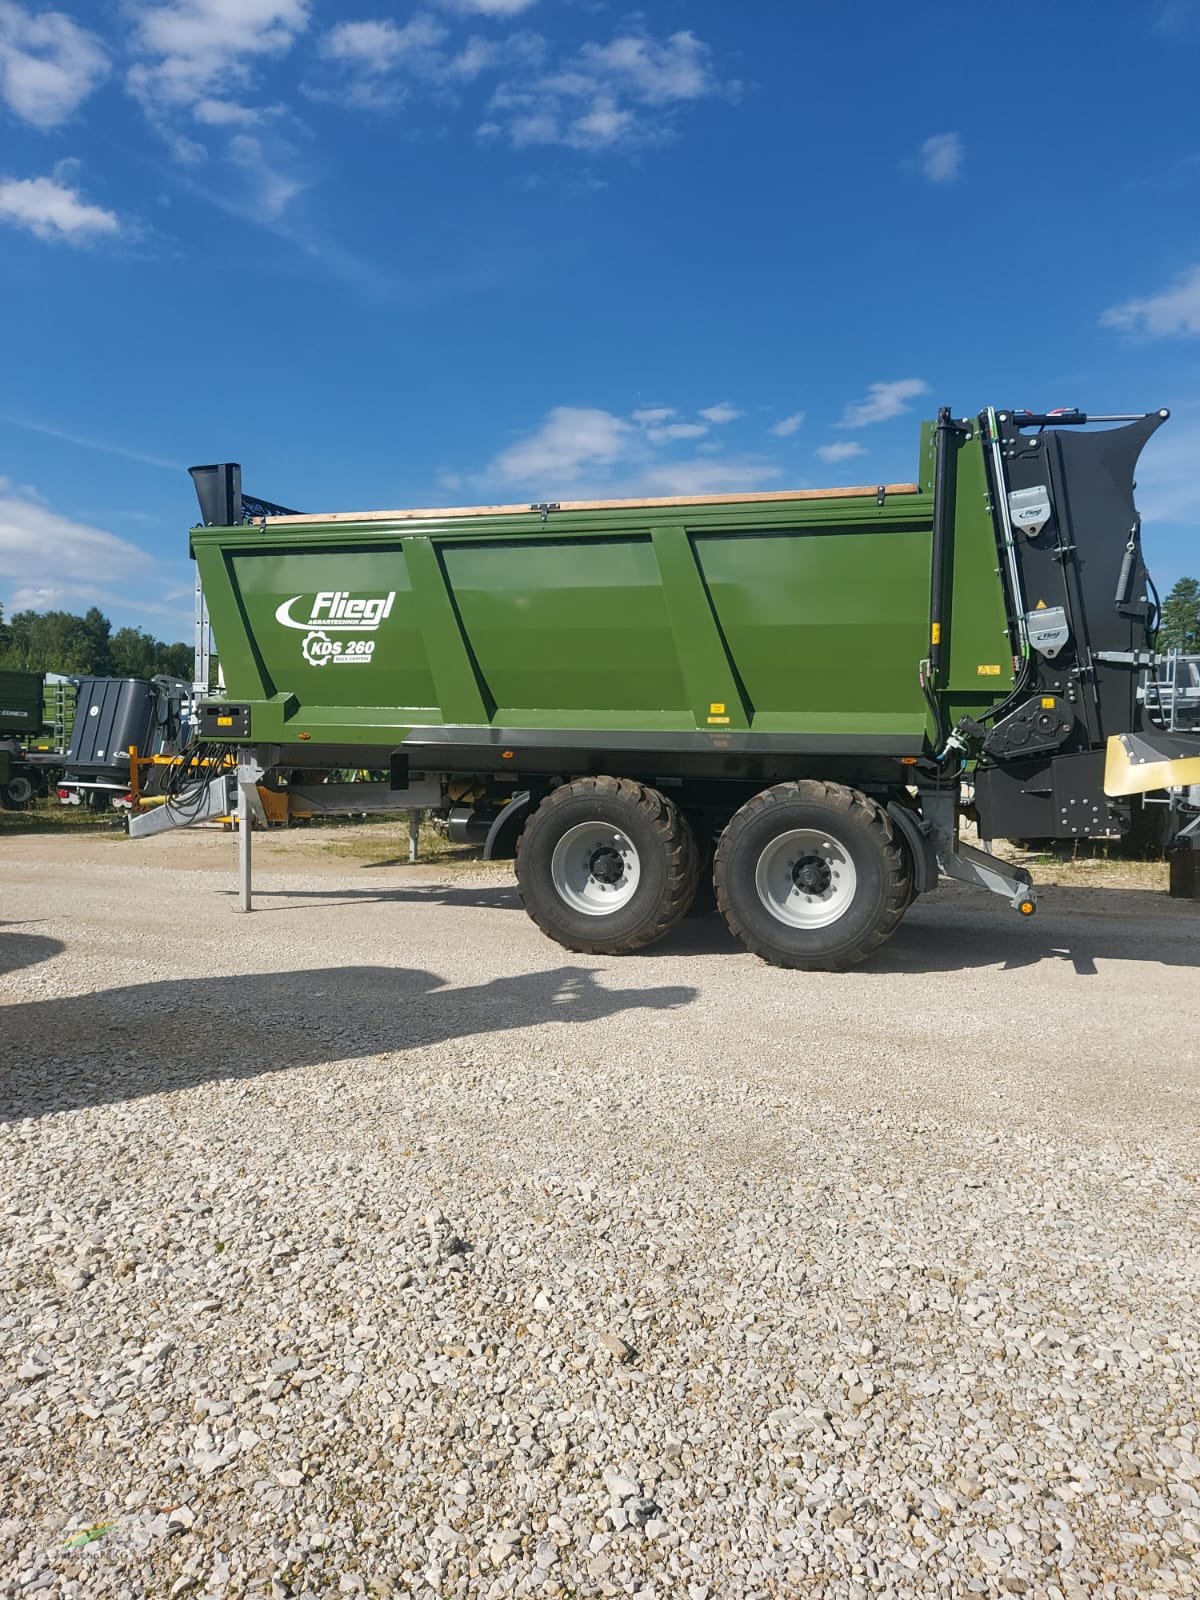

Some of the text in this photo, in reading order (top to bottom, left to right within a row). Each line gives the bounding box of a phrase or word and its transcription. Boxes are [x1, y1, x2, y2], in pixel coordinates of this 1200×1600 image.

[310, 591, 396, 625] Fliegl
[311, 641, 375, 655] KDS 260
